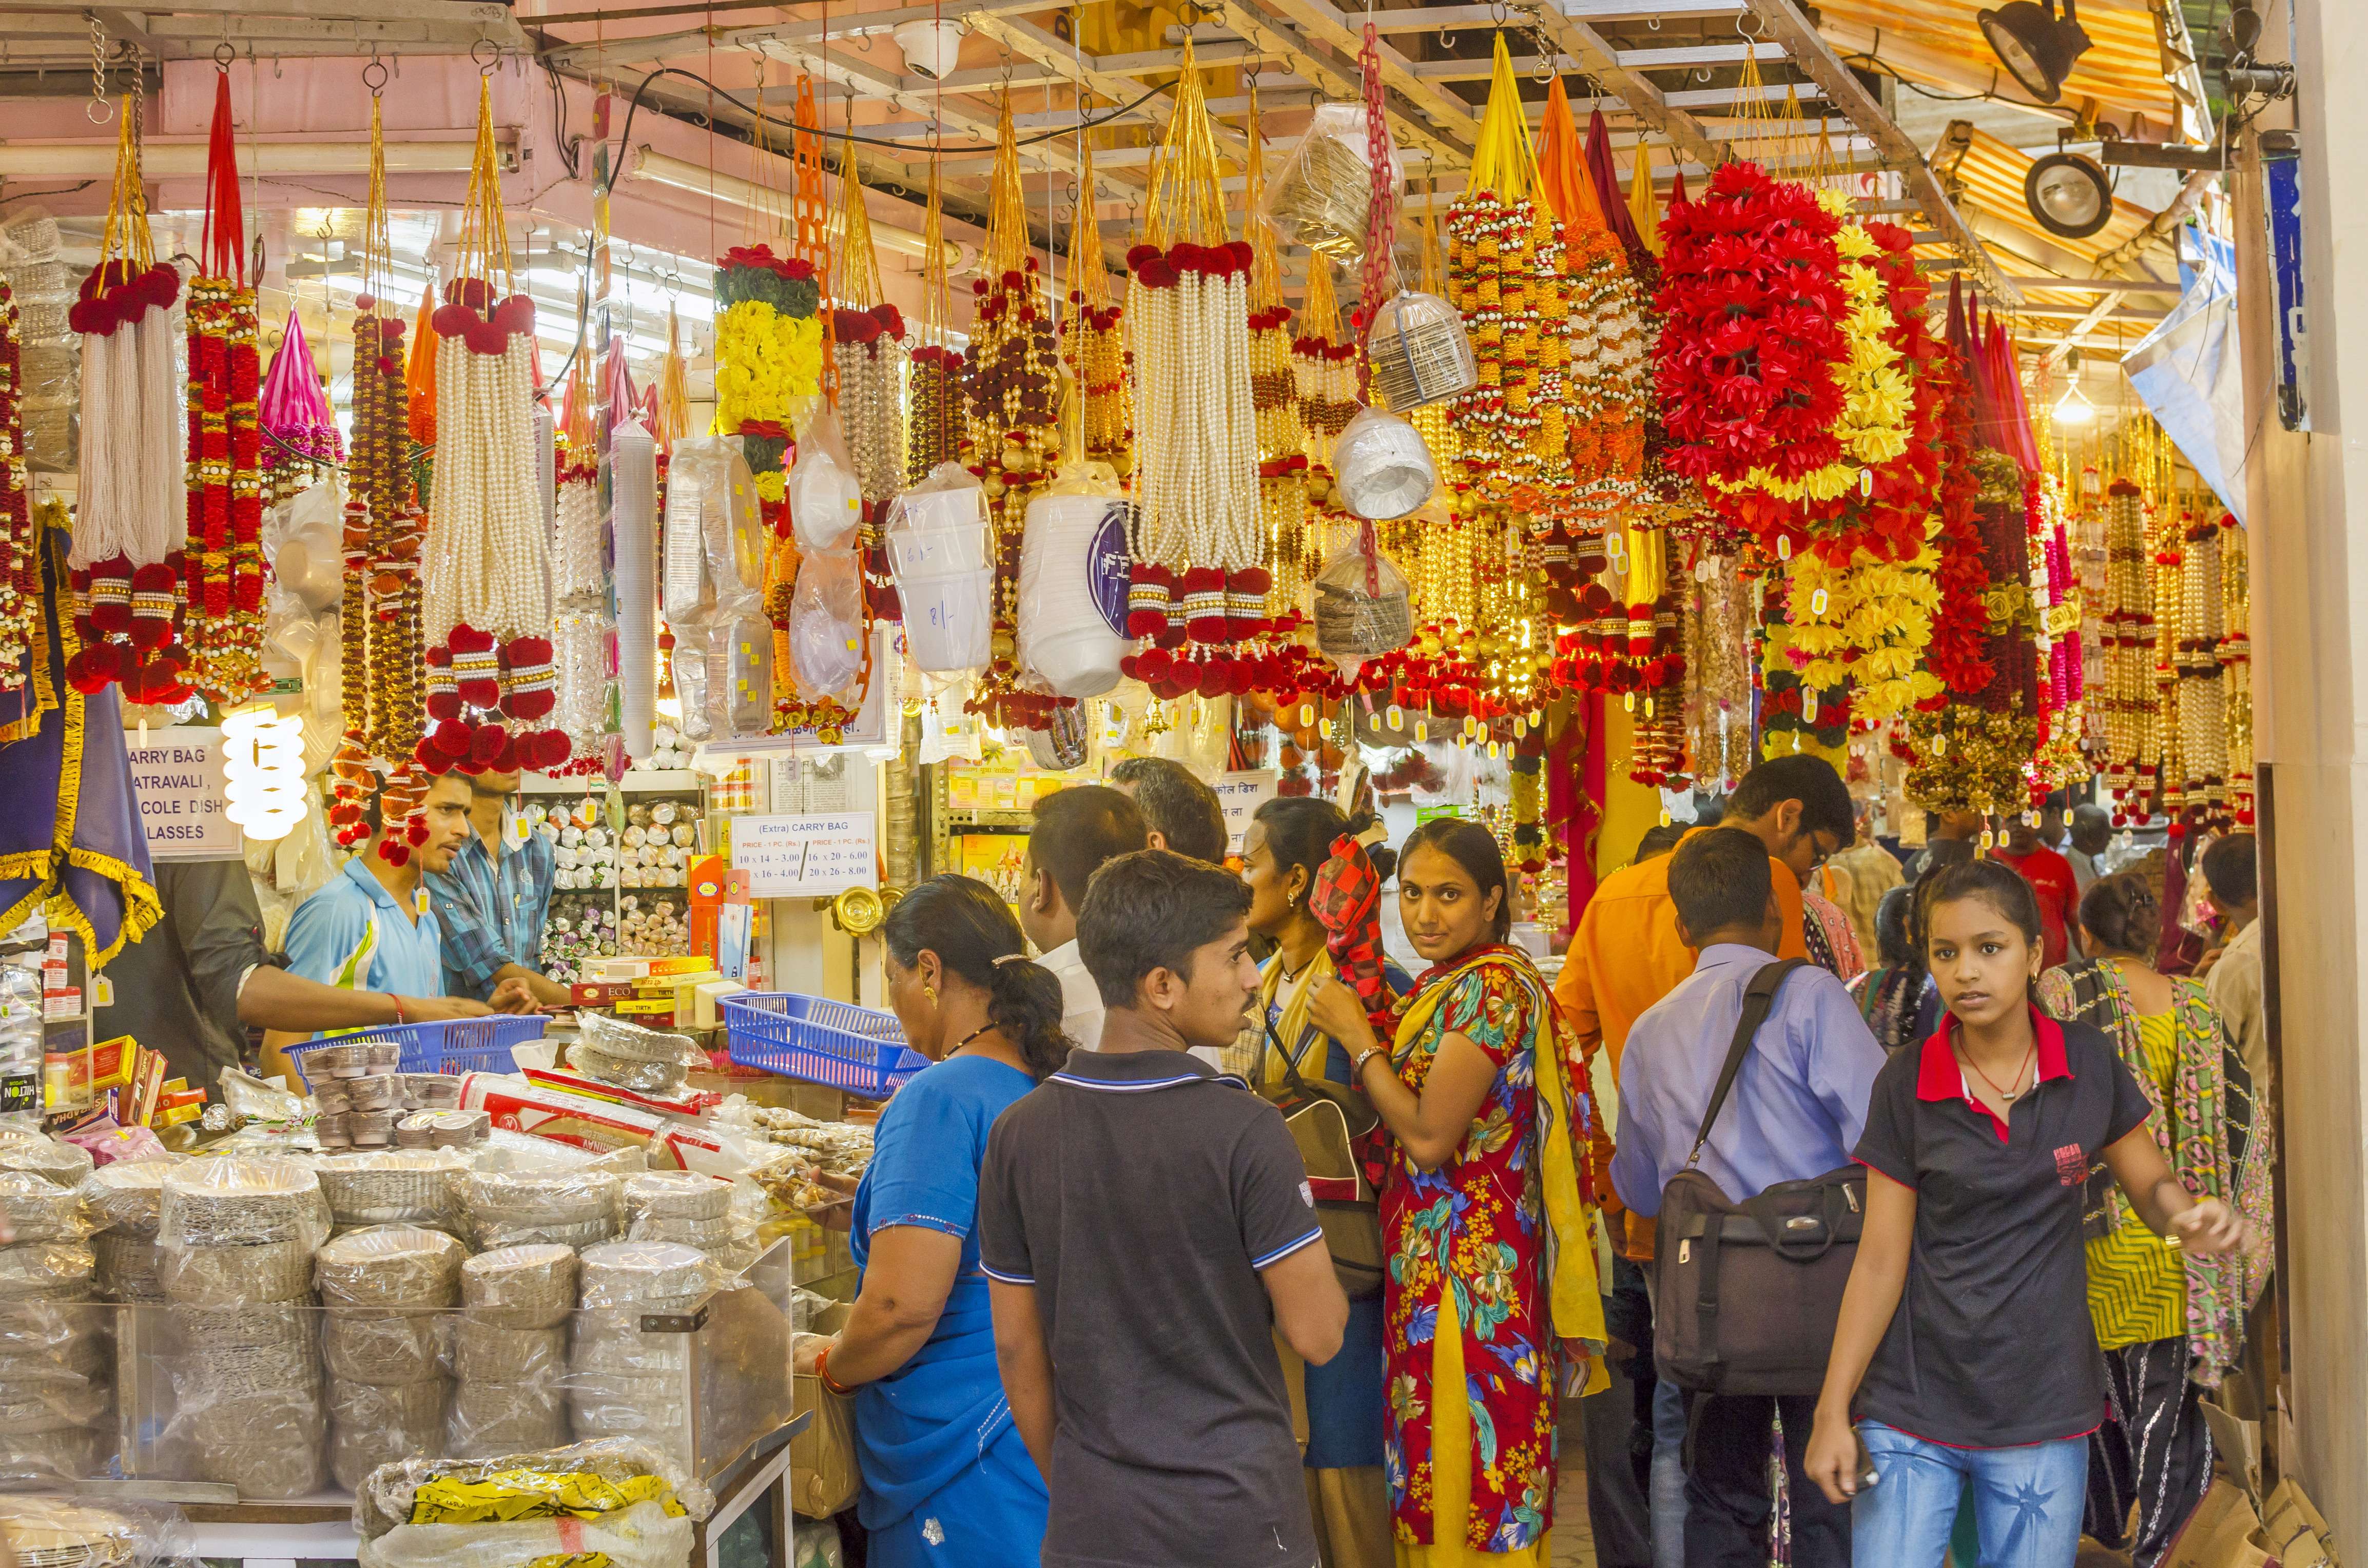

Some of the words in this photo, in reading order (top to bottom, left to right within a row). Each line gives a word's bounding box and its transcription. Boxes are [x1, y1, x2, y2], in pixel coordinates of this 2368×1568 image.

[129, 750, 169, 765] ARRY
[173, 749, 205, 763] BAG
[134, 775, 203, 789] ATRAVALI
[1214, 783, 1235, 795] कोल
[1238, 781, 1258, 793] डिश
[141, 800, 181, 815] COLE
[190, 799, 223, 814] DISH
[1231, 808, 1243, 816] ला
[147, 825, 204, 840] LASSES
[759, 824, 789, 834] (Extra)
[792, 823, 825, 832] CARRY
[828, 822, 848, 830] BAG
[740, 855, 749, 864] 10
[760, 855, 770, 863] 14
[781, 853, 800, 862] 3.00
[808, 853, 818, 861] 16
[831, 852, 841, 860] 20
[849, 851, 867, 860] 6.00
[763, 870, 771, 878] 16
[780, 869, 799, 877] 4.00
[809, 868, 819, 876] 20
[830, 868, 840, 876] 26
[848, 867, 866, 875] 8.00
[608, 987, 631, 996] ECO
[4, 1085, 35, 1098] HILTON
[578, 1128, 592, 1138] CUPS
[592, 1131, 625, 1146] DISPOSABLE
[583, 1139, 617, 1153] BHINAV
